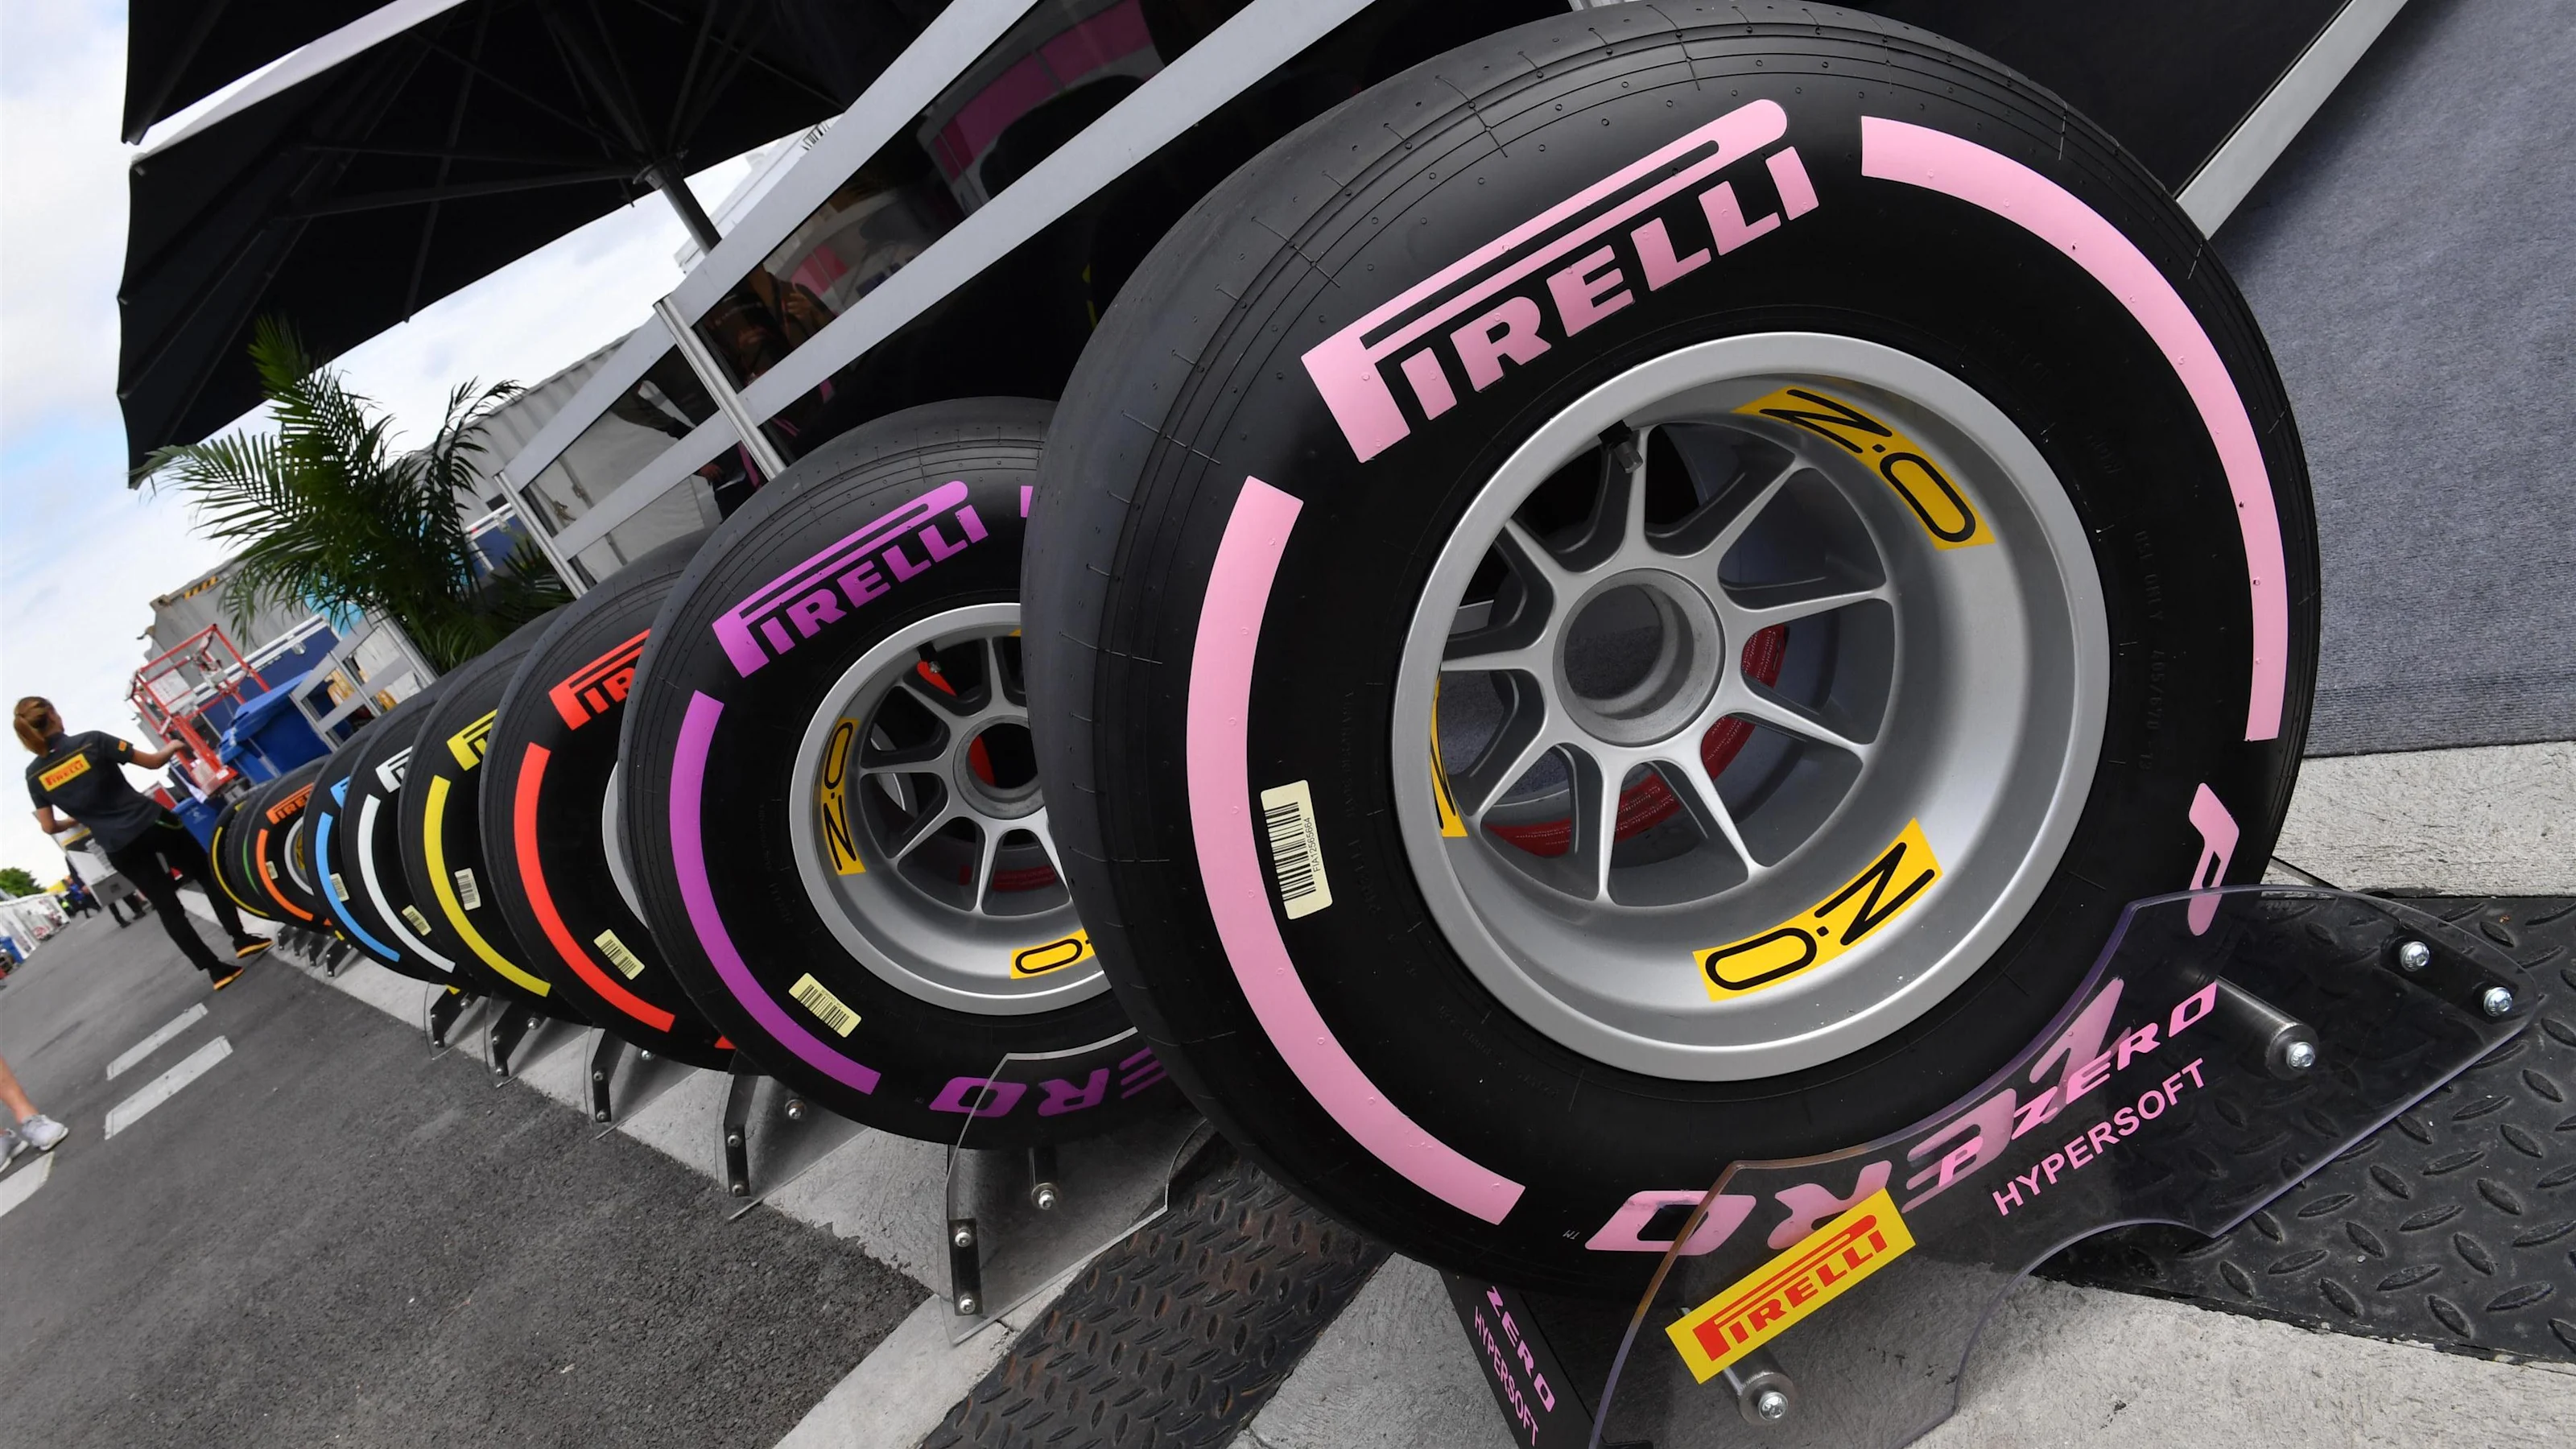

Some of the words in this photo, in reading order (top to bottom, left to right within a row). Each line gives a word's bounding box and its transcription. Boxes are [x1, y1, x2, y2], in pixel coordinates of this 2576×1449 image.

[1302, 98, 1819, 464] PIRELLI
[712, 480, 989, 679] PIRELLI
[266, 782, 315, 824] PIRE
[928, 1046, 1167, 1117] ERO
[1938, 1135, 1984, 1187] P
[2011, 981, 2218, 1141] ZERO
[1992, 1057, 2206, 1216] HYPERSOFT
[1486, 1286, 1556, 1413] ZERO
[1692, 1214, 1889, 1362] PIRELLI
[1474, 1305, 1539, 1447] HYPERSOFT
